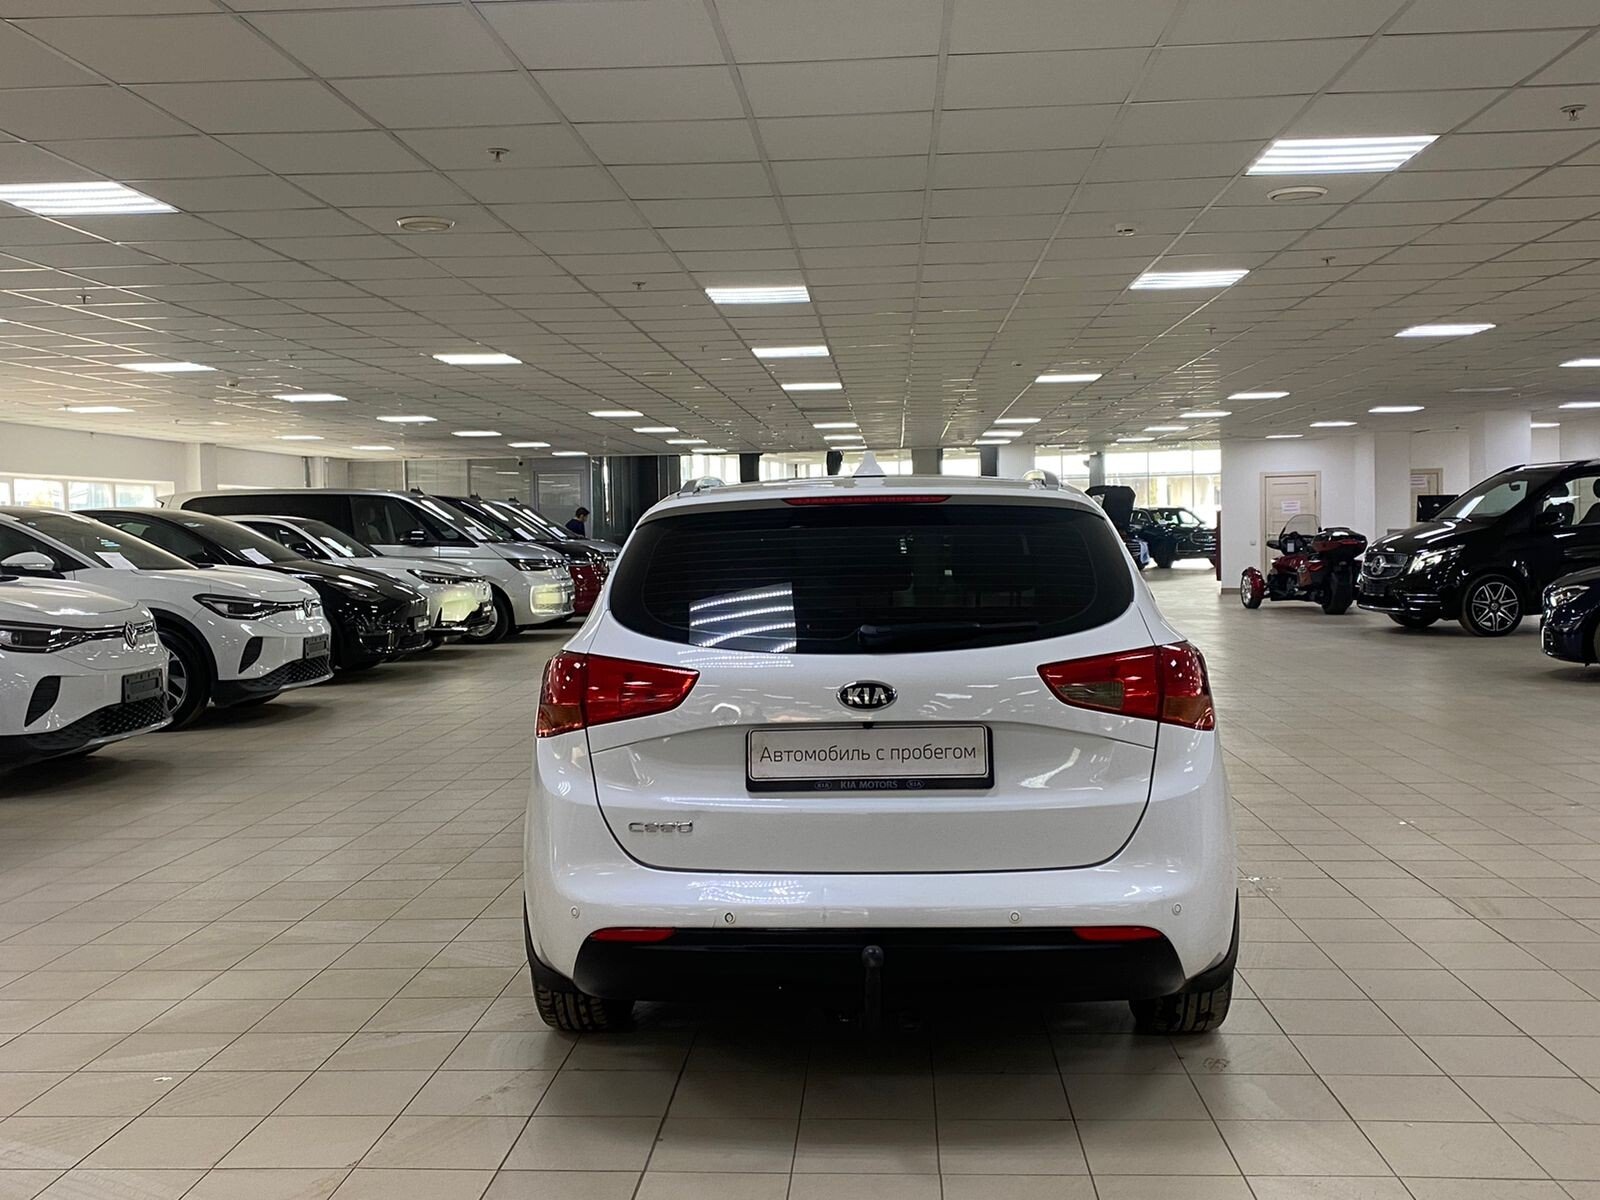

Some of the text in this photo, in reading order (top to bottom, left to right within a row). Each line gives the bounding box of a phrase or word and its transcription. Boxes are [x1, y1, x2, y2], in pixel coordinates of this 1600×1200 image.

[847, 687, 888, 704] KIA
[760, 744, 977, 763] Автомобиль с пробегом
[840, 780, 898, 789] KIA MOTORS
